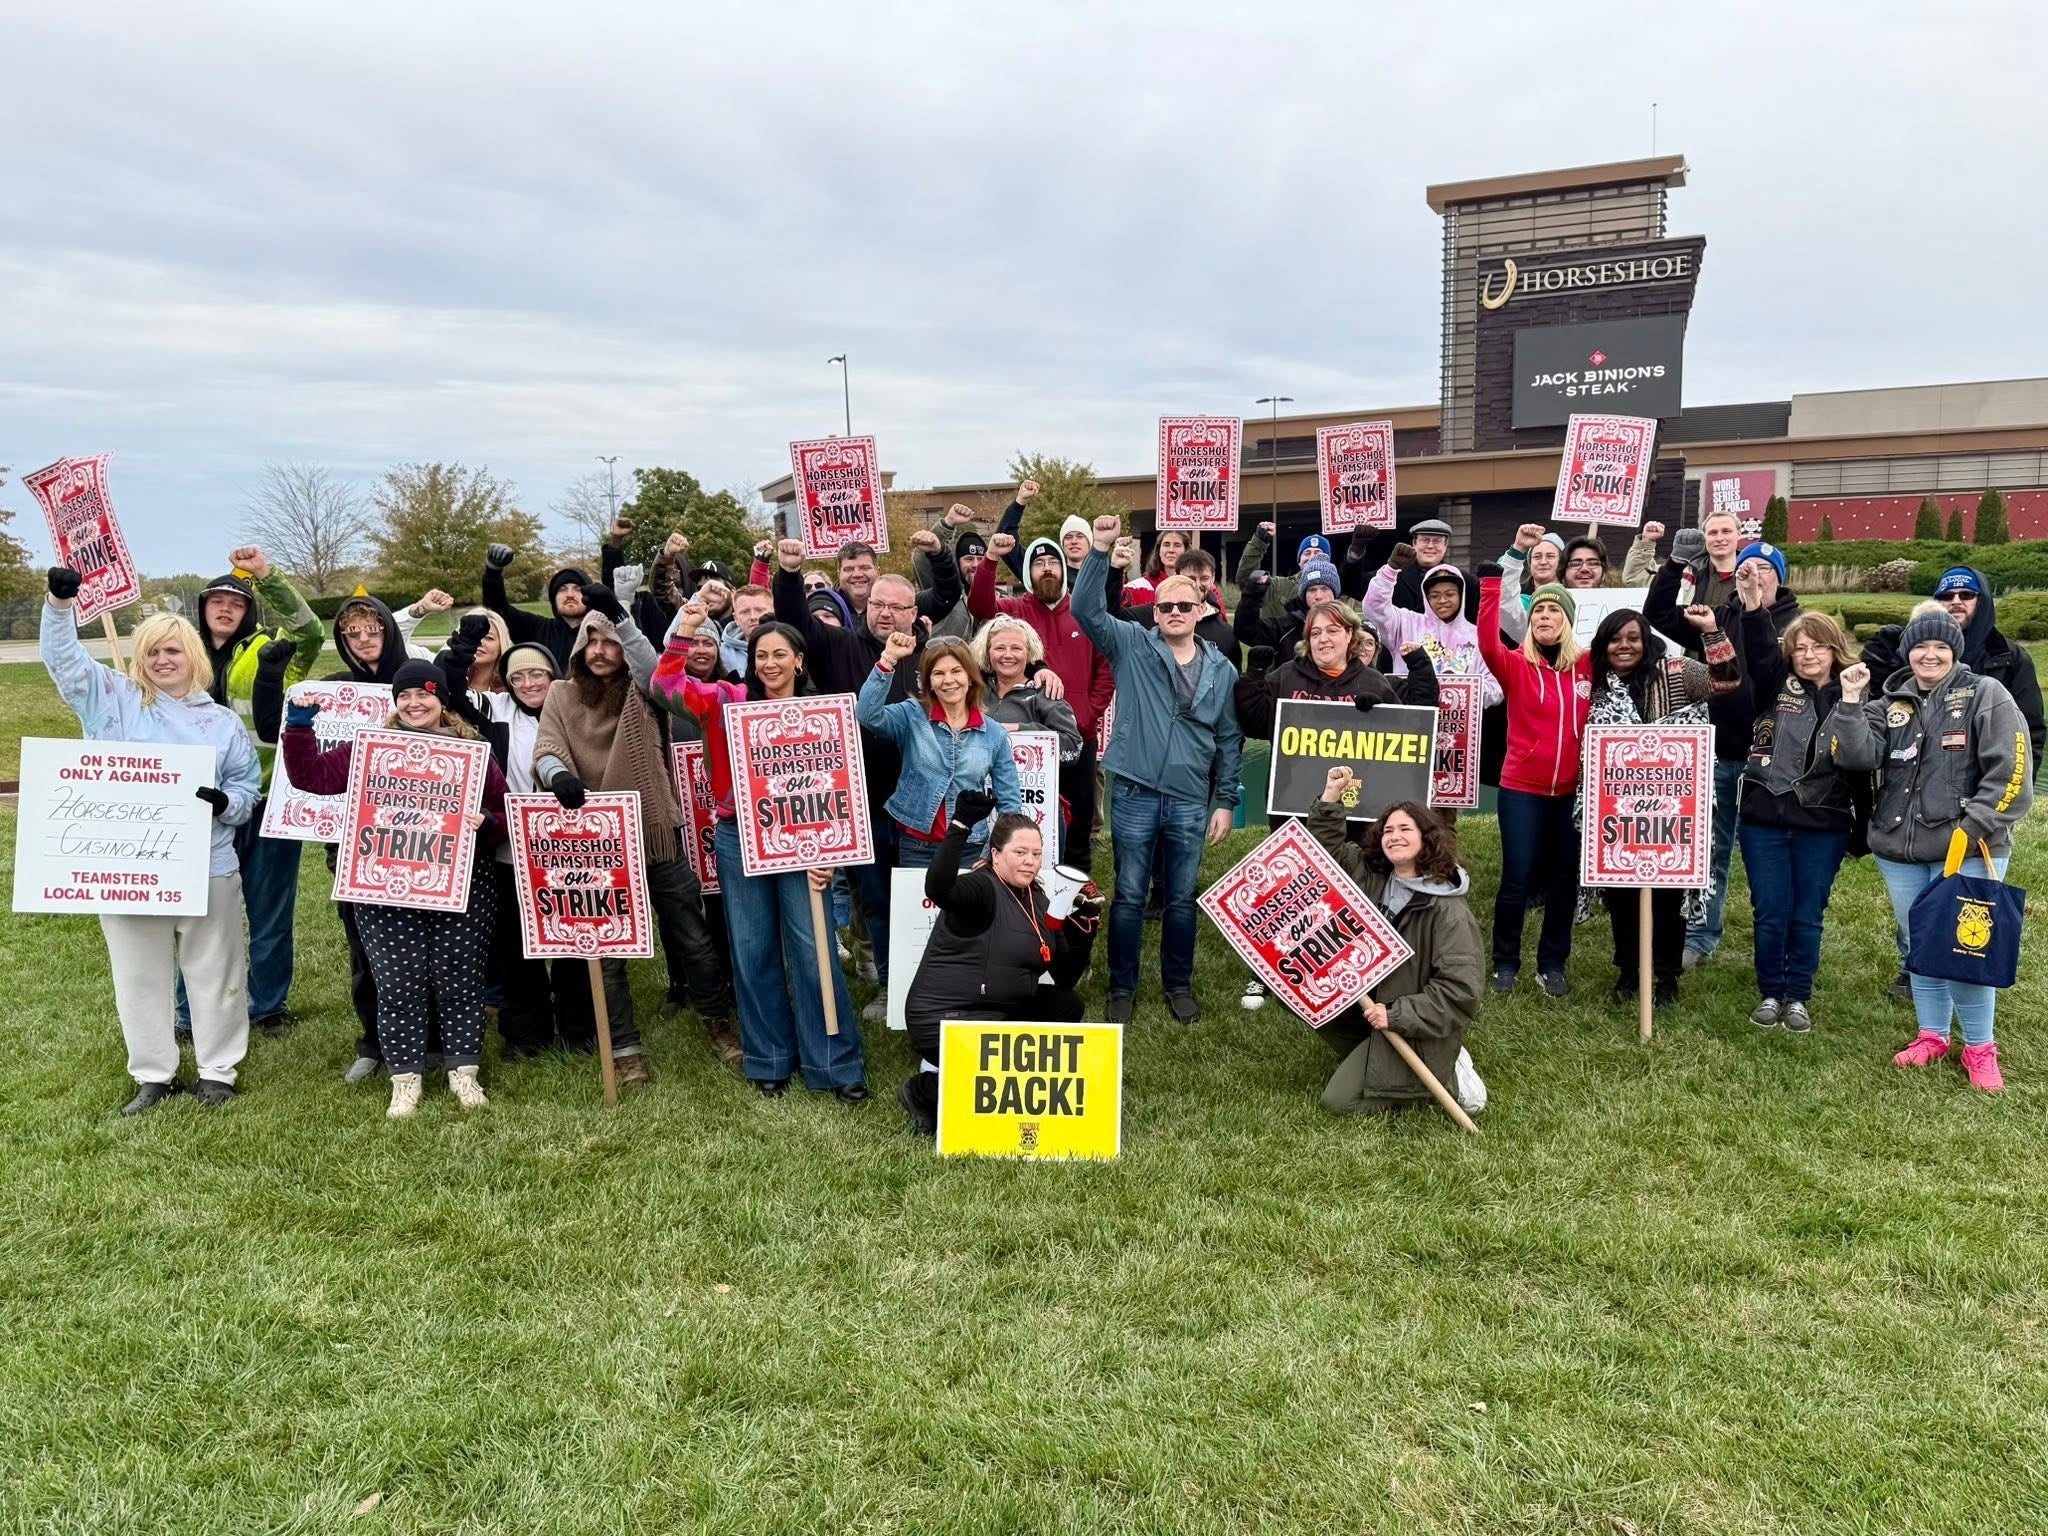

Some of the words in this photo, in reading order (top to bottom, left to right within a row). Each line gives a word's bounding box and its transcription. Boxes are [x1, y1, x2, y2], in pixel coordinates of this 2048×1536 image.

[1523, 256, 1688, 292] HORSESHOE
[1531, 372, 1578, 387] JACK
[1584, 366, 1665, 383] BINION'S
[1170, 446, 1227, 456] HORSESHOE
[1330, 450, 1384, 464] HORSESHOE
[1578, 442, 1638, 455] HORSESHOE
[1170, 457, 1227, 467] TEAMSTERS
[1331, 460, 1384, 474] TEAMSTERS
[1577, 453, 1637, 465] TEAMSTERS
[807, 467, 866, 481] HORSESHOE
[1189, 467, 1206, 479] on
[1594, 463, 1613, 473] on
[809, 479, 867, 493] TEAMSTERS
[1349, 472, 1366, 483] on
[1572, 473, 1633, 497] STRIKE
[1712, 478, 1740, 492] WORLD
[830, 491, 848, 503] on
[1170, 480, 1227, 501] STRIKE
[1333, 482, 1386, 506] STRIKE
[1712, 489, 1740, 503] SERIES
[55, 488, 99, 519] HORSESHOE
[1725, 499, 1750, 513] POKER
[58, 503, 103, 535] TEAMSTERS
[812, 502, 872, 527] STRIKE
[73, 529, 89, 546] on
[66, 534, 117, 576] STRIKE
[750, 740, 842, 761] HORSESHOE
[1281, 726, 1428, 764] ORGANIZE!
[80, 755, 103, 767] ON
[107, 756, 163, 769] STRIKE
[752, 756, 843, 777] TEAMSTERS
[59, 768, 104, 781] ONLY
[108, 770, 181, 785] AGAINST
[1604, 767, 1693, 781] HORSESHOE
[366, 774, 462, 798] HORSESHOE
[786, 775, 815, 793] on
[1604, 783, 1692, 796] TEAMSTERS
[366, 791, 459, 814] TEAMSTERS
[757, 790, 850, 829] STRIKE
[1634, 798, 1662, 813] on
[392, 811, 424, 826] on
[1602, 816, 1692, 844] STRIKE
[358, 827, 455, 865] STRIKE
[530, 839, 622, 853] HORSESHOE
[532, 854, 624, 869] TEAMSTERS
[72, 871, 159, 886] TEAMSTERS
[564, 870, 593, 886] on
[44, 887, 94, 900] LOCAL
[100, 889, 150, 902] UNION
[156, 891, 182, 903] 135
[537, 887, 630, 918] STRIKE
[1242, 865, 1319, 935] HORSESHOE
[1253, 880, 1329, 947] TEAMSTERS
[1290, 914, 1315, 942] on
[1277, 906, 1366, 986] STRIKE
[979, 1034, 1085, 1073] FIGHT
[974, 1075, 1085, 1117] BACK!
